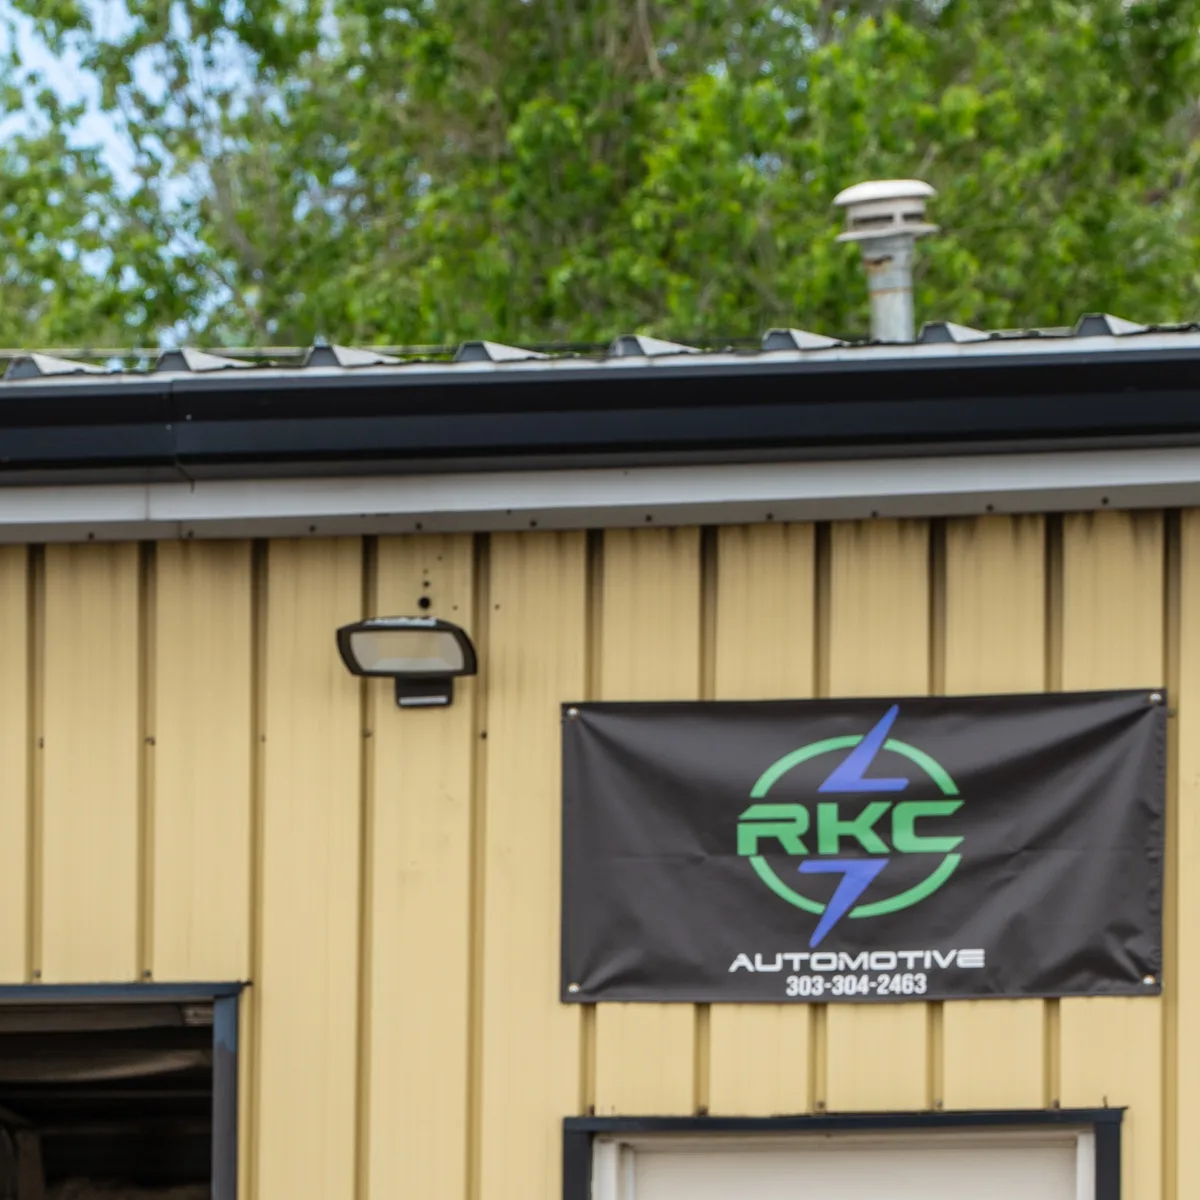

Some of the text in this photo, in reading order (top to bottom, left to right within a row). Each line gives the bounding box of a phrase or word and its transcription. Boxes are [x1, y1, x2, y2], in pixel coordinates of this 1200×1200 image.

[737, 800, 965, 856] RKC
[728, 948, 986, 973] AUTOMOTIVE
[786, 973, 927, 997] 303-304-2463
